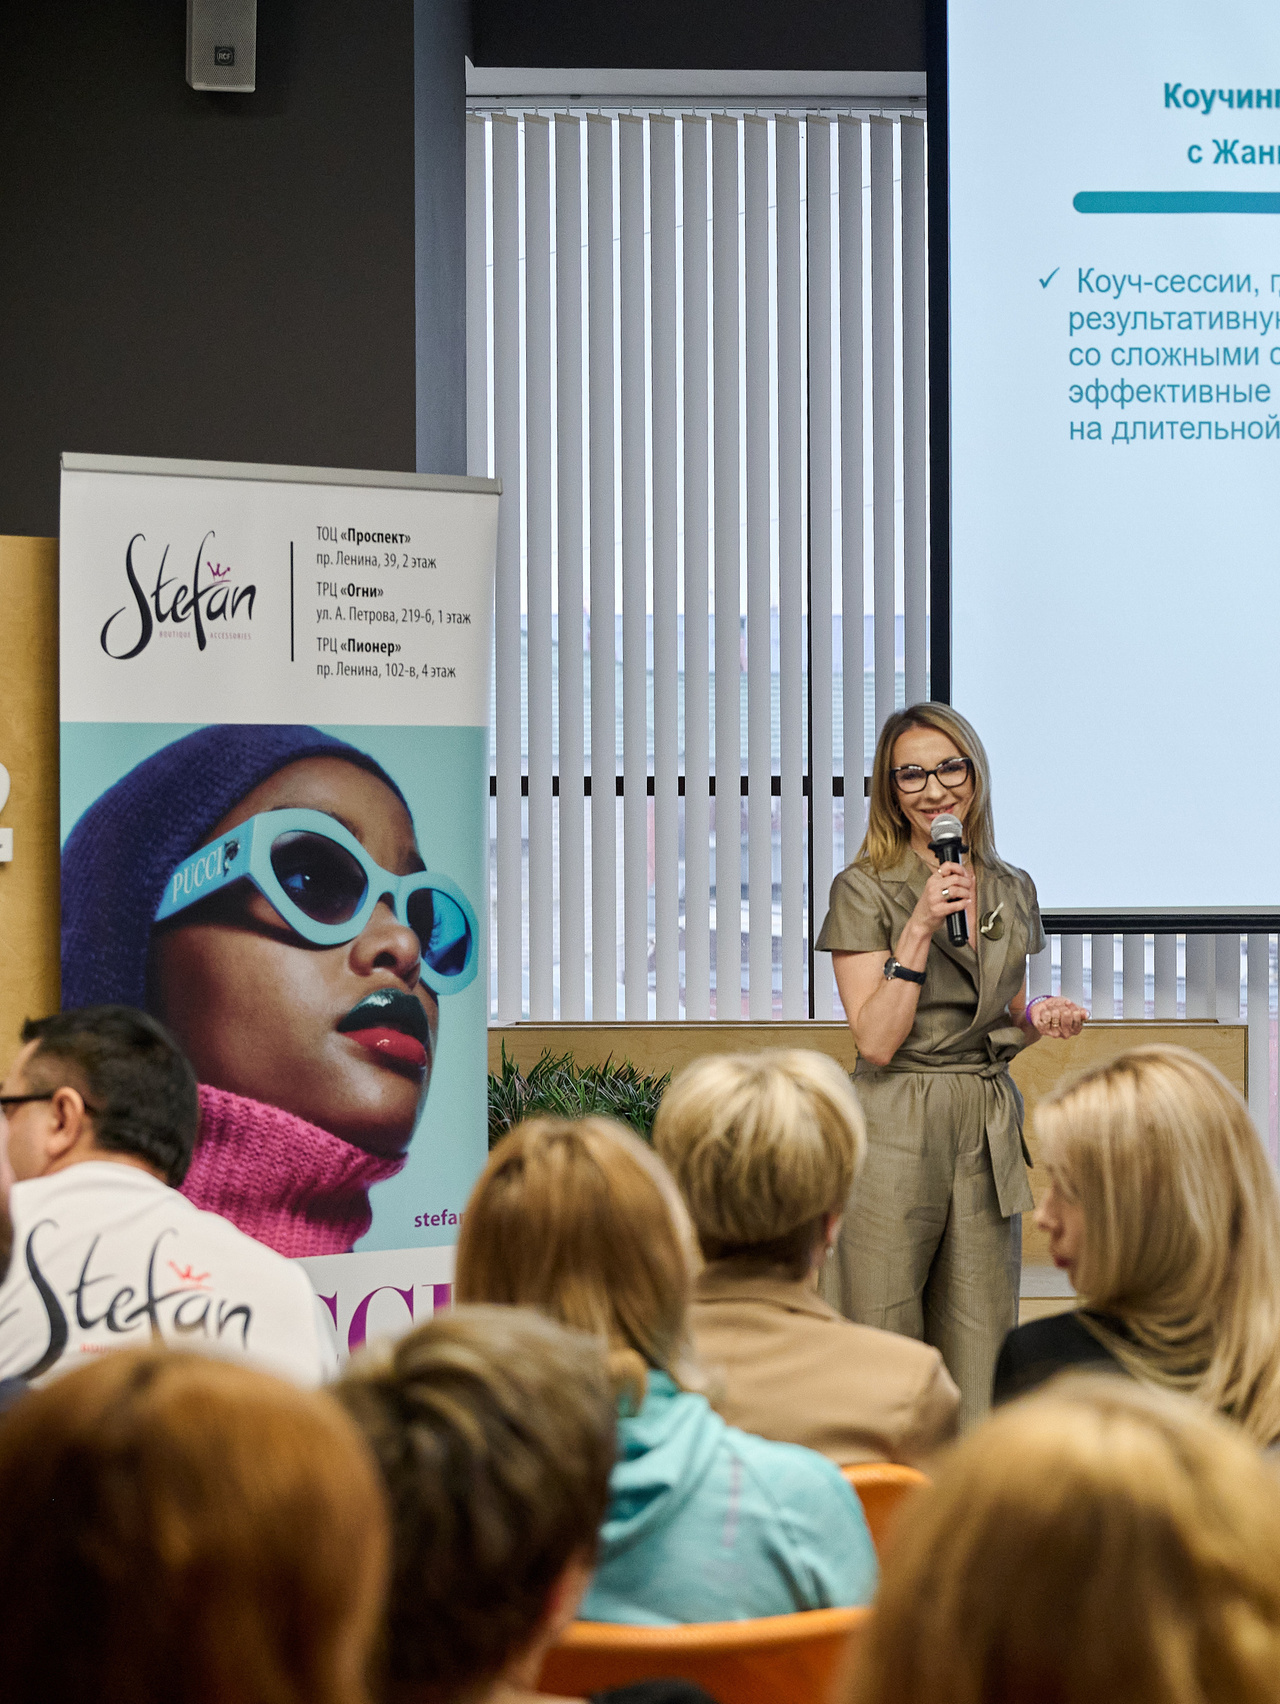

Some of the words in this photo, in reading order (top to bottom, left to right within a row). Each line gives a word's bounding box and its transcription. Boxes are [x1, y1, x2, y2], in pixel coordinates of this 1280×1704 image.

[1187, 144, 1204, 165] с
[1077, 267, 1260, 299] Коуч-сессии,
[1069, 346, 1102, 367] со
[1110, 345, 1260, 367] сложными
[1068, 377, 1271, 410] эффективные
[1069, 420, 1103, 441] на
[1111, 413, 1280, 446] длительной
[316, 526, 338, 543] ТОЦ
[340, 527, 411, 545] «Проспект»
[316, 553, 334, 568] пр.
[336, 551, 381, 569] Ленина,
[383, 553, 400, 569] 39,
[402, 554, 409, 568] 2
[411, 556, 437, 569] этаж
[100, 530, 256, 660] Stefan
[316, 581, 338, 599] ТРЦ
[340, 583, 384, 598] «Огни»
[316, 609, 332, 623] ул.
[335, 606, 346, 621] А.
[349, 606, 399, 625] Петрова,
[438, 610, 443, 623] 1
[446, 612, 472, 624] этаж
[316, 637, 338, 654] ТРЦ
[340, 638, 402, 656] «Пионер»
[316, 663, 334, 679] пр.
[336, 661, 381, 678] Ленина,
[421, 664, 428, 677] 4
[430, 666, 456, 679] этаж
[172, 846, 225, 904] PUCCI
[414, 1209, 465, 1228] stefa
[0, 1218, 252, 1382] Stefan
